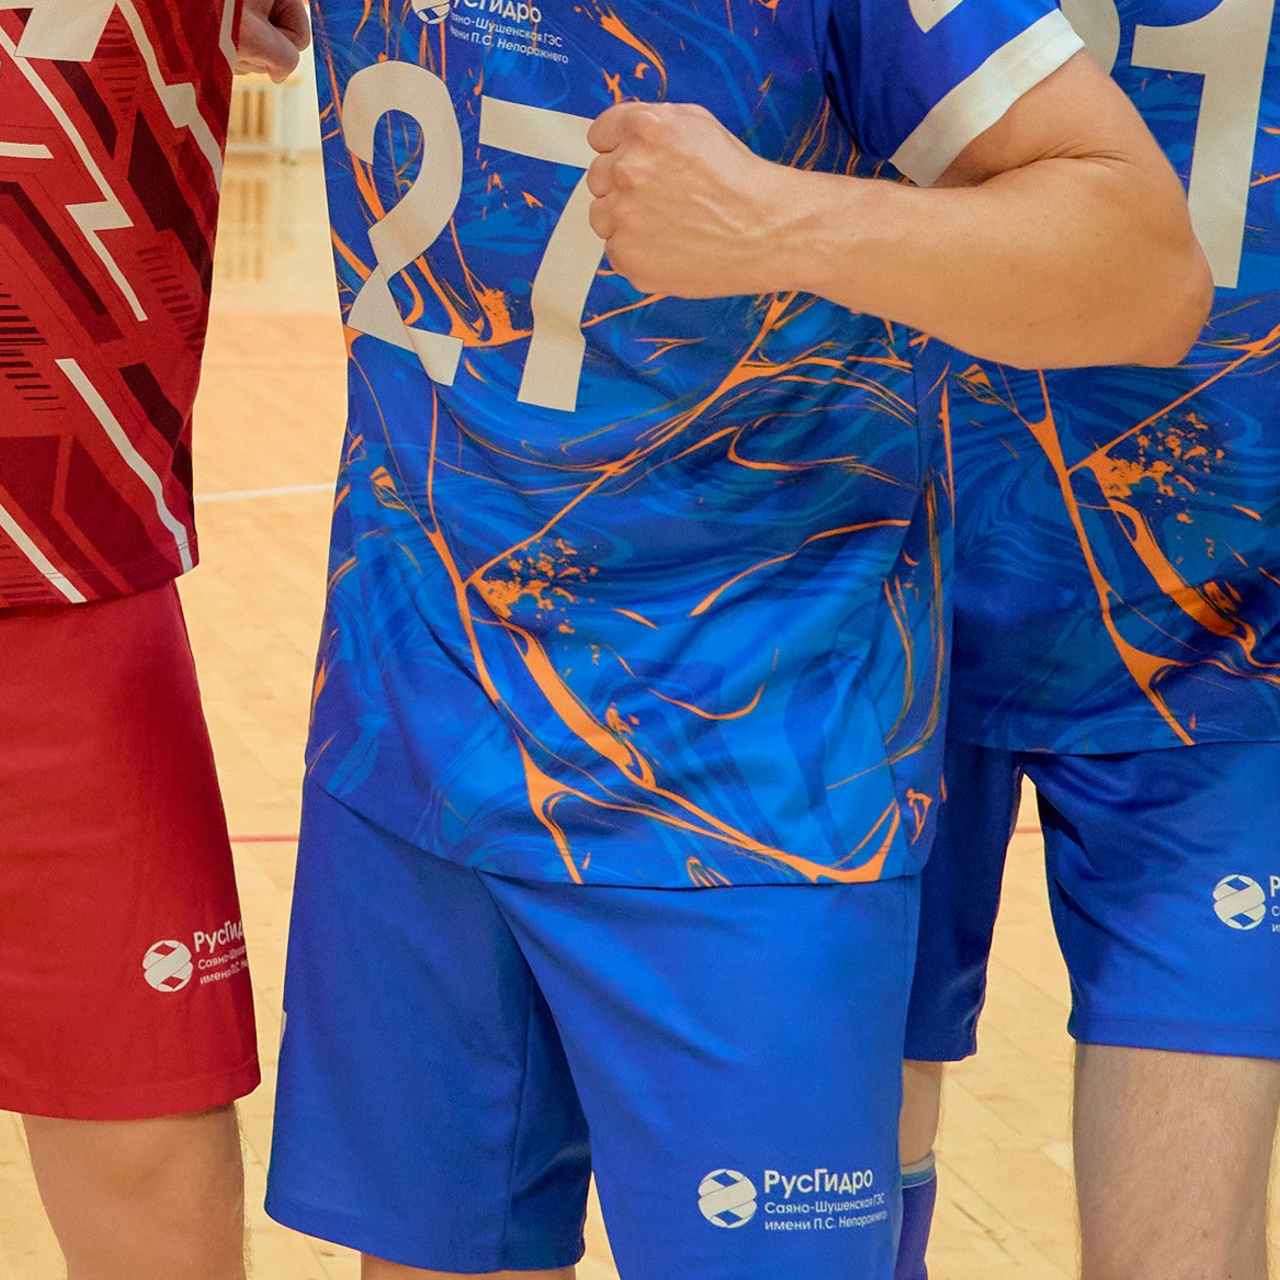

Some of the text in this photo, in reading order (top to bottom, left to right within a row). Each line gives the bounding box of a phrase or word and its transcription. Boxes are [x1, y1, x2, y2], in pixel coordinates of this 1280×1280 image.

[471, 31, 496, 48] П.С.
[497, 38, 569, 64] Непорожнего
[543, 32, 563, 48] ГЭС
[342, 60, 600, 412] 27
[764, 1168, 874, 1199] РусГидро
[764, 1198, 873, 1215] Саяно-Шушенская
[764, 1221, 811, 1231] имени
[814, 1217, 837, 1230] П.С.
